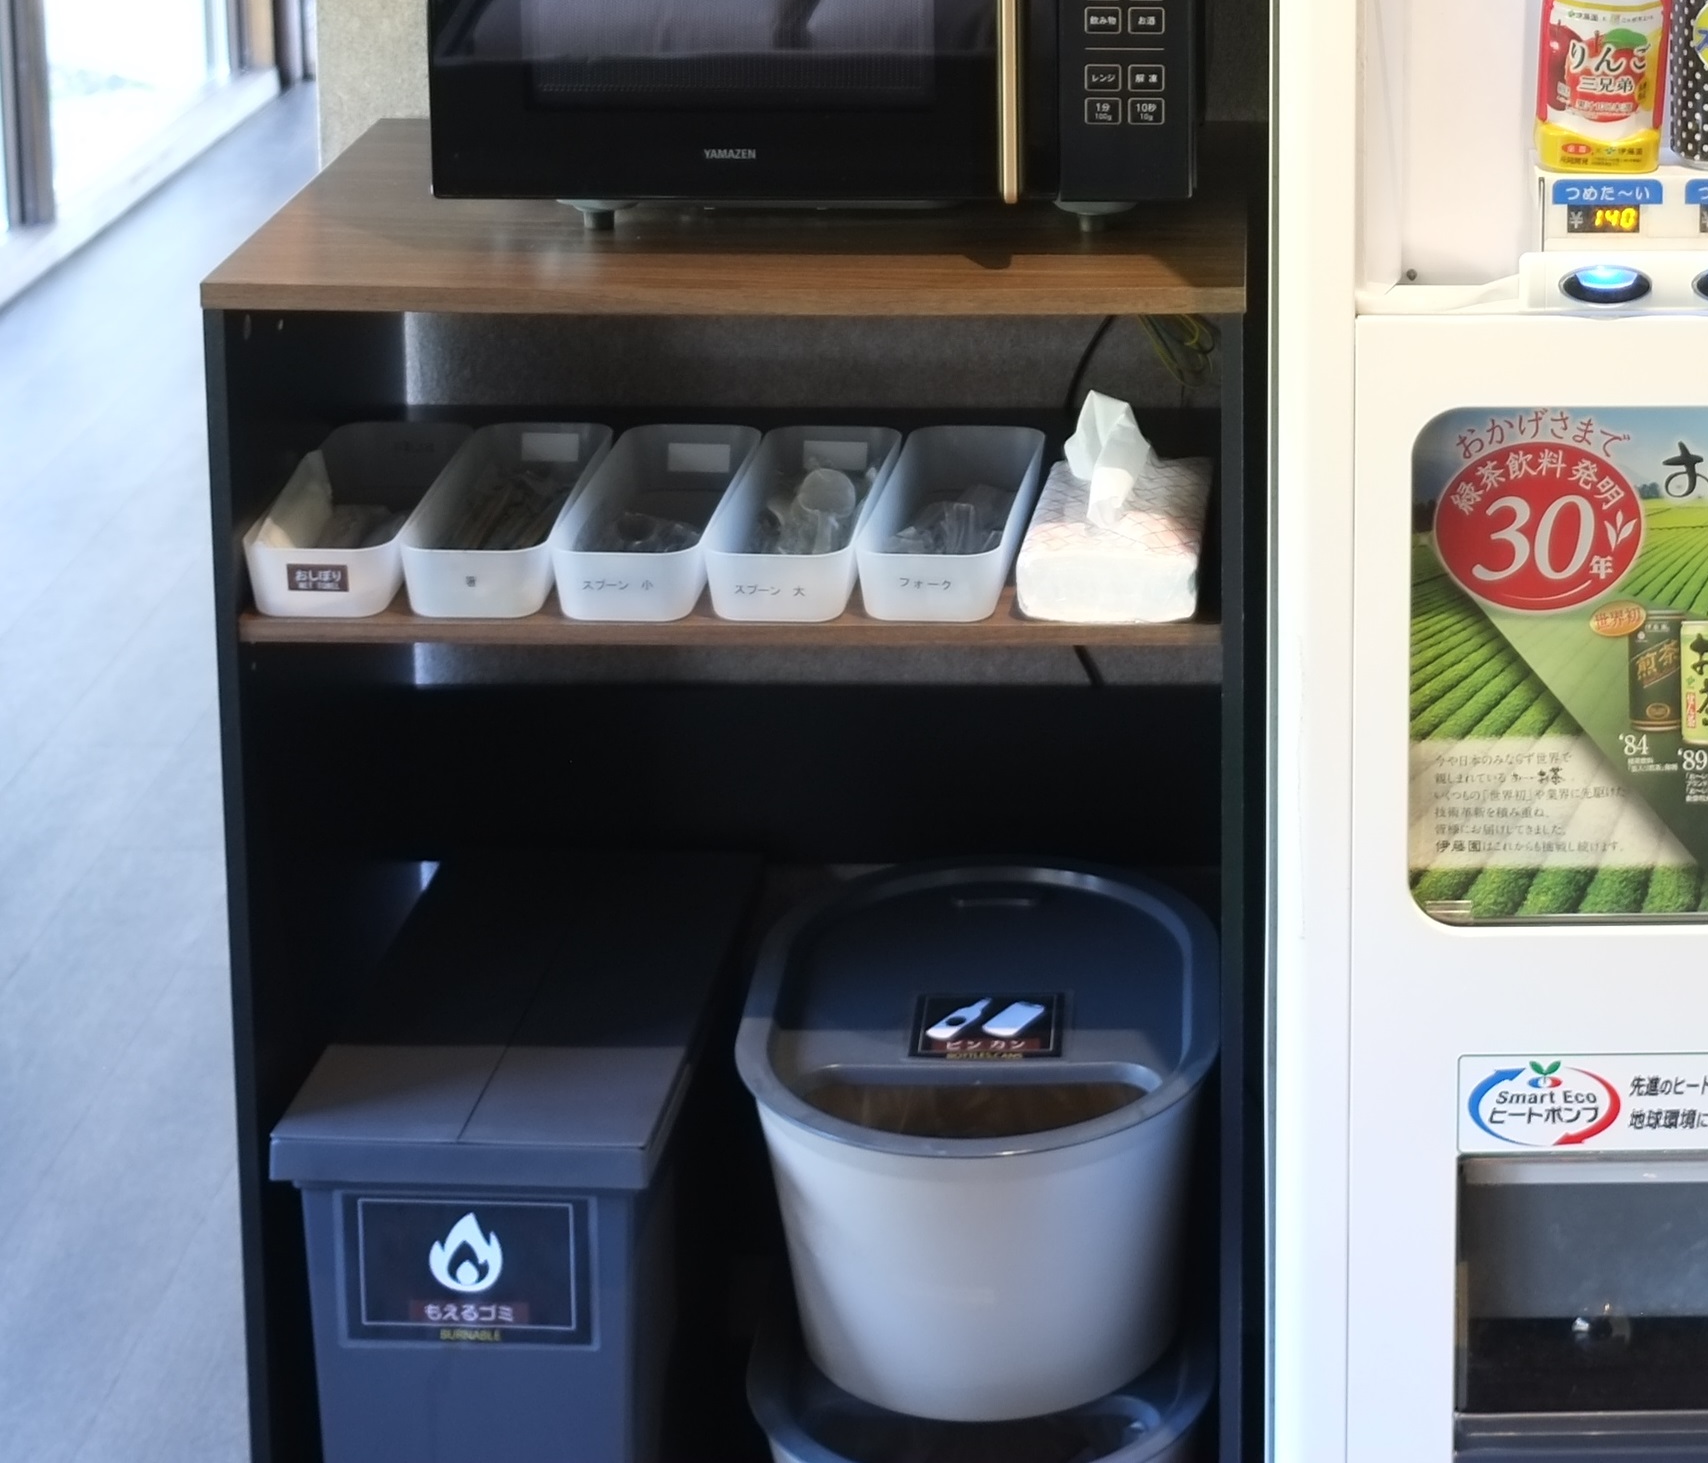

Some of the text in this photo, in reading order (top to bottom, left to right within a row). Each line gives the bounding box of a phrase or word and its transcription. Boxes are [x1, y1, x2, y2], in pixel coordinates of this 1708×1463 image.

[1089, 16, 1117, 26] 飲み物
[1137, 16, 1156, 26] お酒
[1569, 41, 1651, 73] りんご
[1092, 74, 1116, 83] レンジ
[1579, 77, 1634, 93] 三兄弟
[1095, 102, 1110, 113] 1分
[1136, 102, 1157, 113] 10秒
[704, 148, 756, 159] YAMAZEN
[1456, 408, 1632, 460] おかげさまで
[1450, 448, 1626, 516] 緑茶飲料発明
[295, 569, 342, 583] おしぼり
[582, 579, 654, 592] スプーン 小
[735, 584, 806, 598] スプーン 大
[898, 577, 952, 591] フォーク
[1594, 606, 1643, 628] 世界初
[946, 1039, 1026, 1051] ビン カン
[1495, 1089, 1597, 1105] Smart Eco
[1489, 1107, 1599, 1125] ヒートポンプ
[424, 1304, 513, 1322] もえるゴミ
